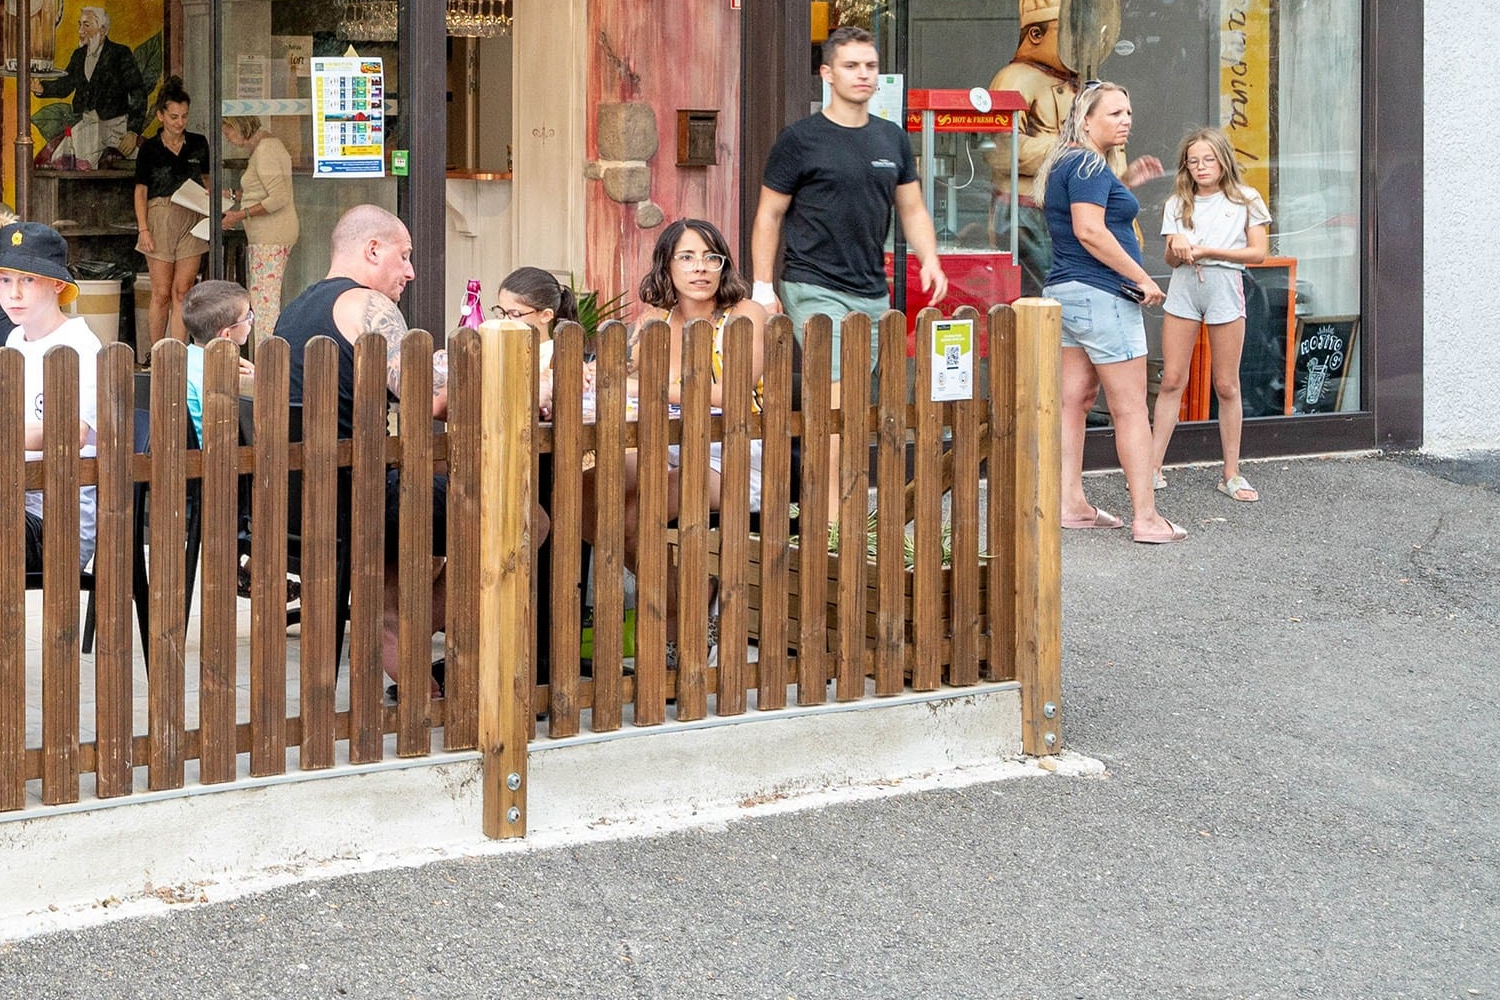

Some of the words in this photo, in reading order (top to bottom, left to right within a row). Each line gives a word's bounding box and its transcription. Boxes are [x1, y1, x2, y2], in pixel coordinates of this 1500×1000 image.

[952, 116, 965, 124] HOT
[973, 116, 994, 124] FRESH
[1301, 334, 1343, 355] MOJITO
